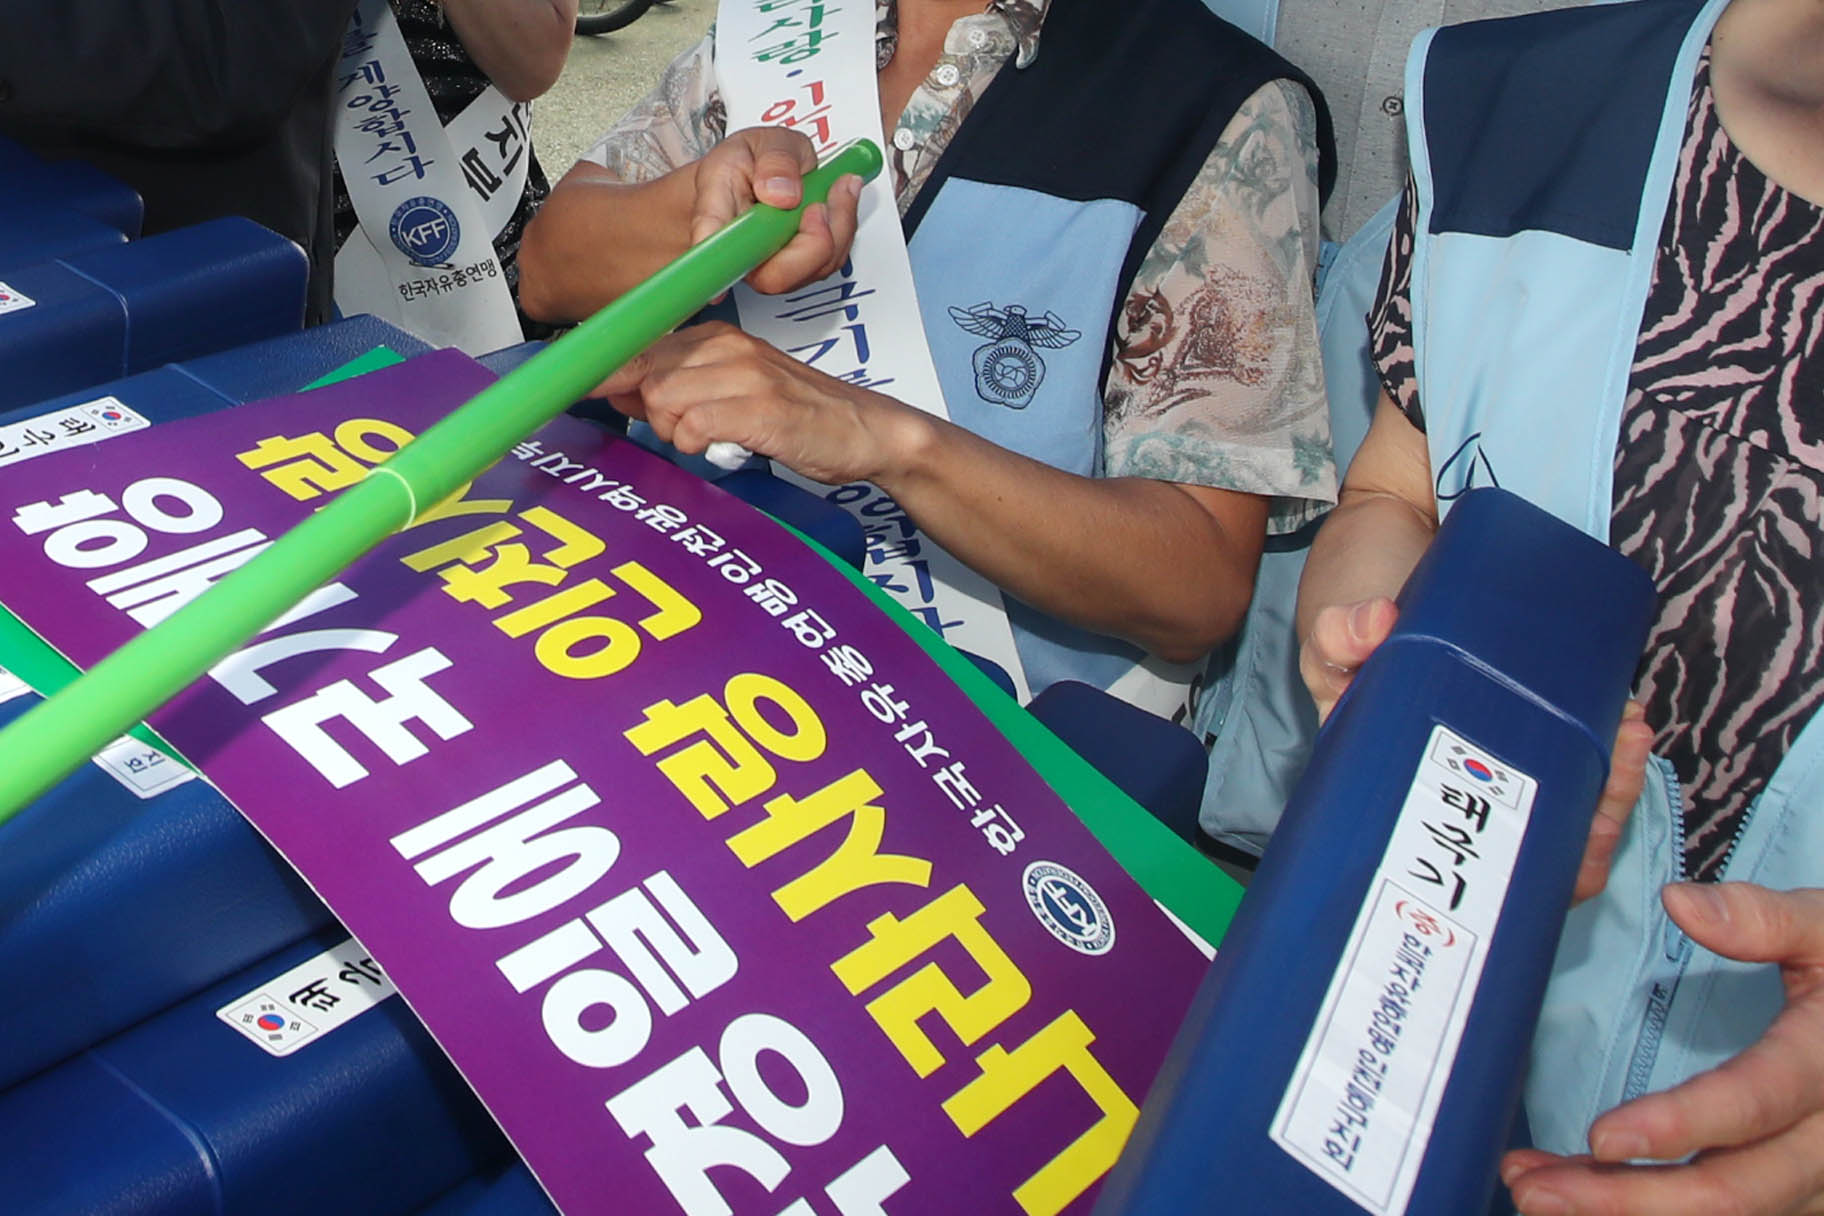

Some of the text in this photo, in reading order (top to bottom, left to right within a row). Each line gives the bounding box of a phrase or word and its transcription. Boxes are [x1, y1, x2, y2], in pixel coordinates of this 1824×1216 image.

[398, 257, 498, 302] 한국자유총연맹
[402, 217, 446, 247] KFF
[510, 440, 1027, 857] 한국자유총연맹인천광역시지부
[1043, 880, 1098, 937] KFF
[1408, 783, 1492, 912] 태극기
[623, 673, 1141, 1216] 나라사랑
[1370, 934, 1434, 1056] 한국자유총연맹
